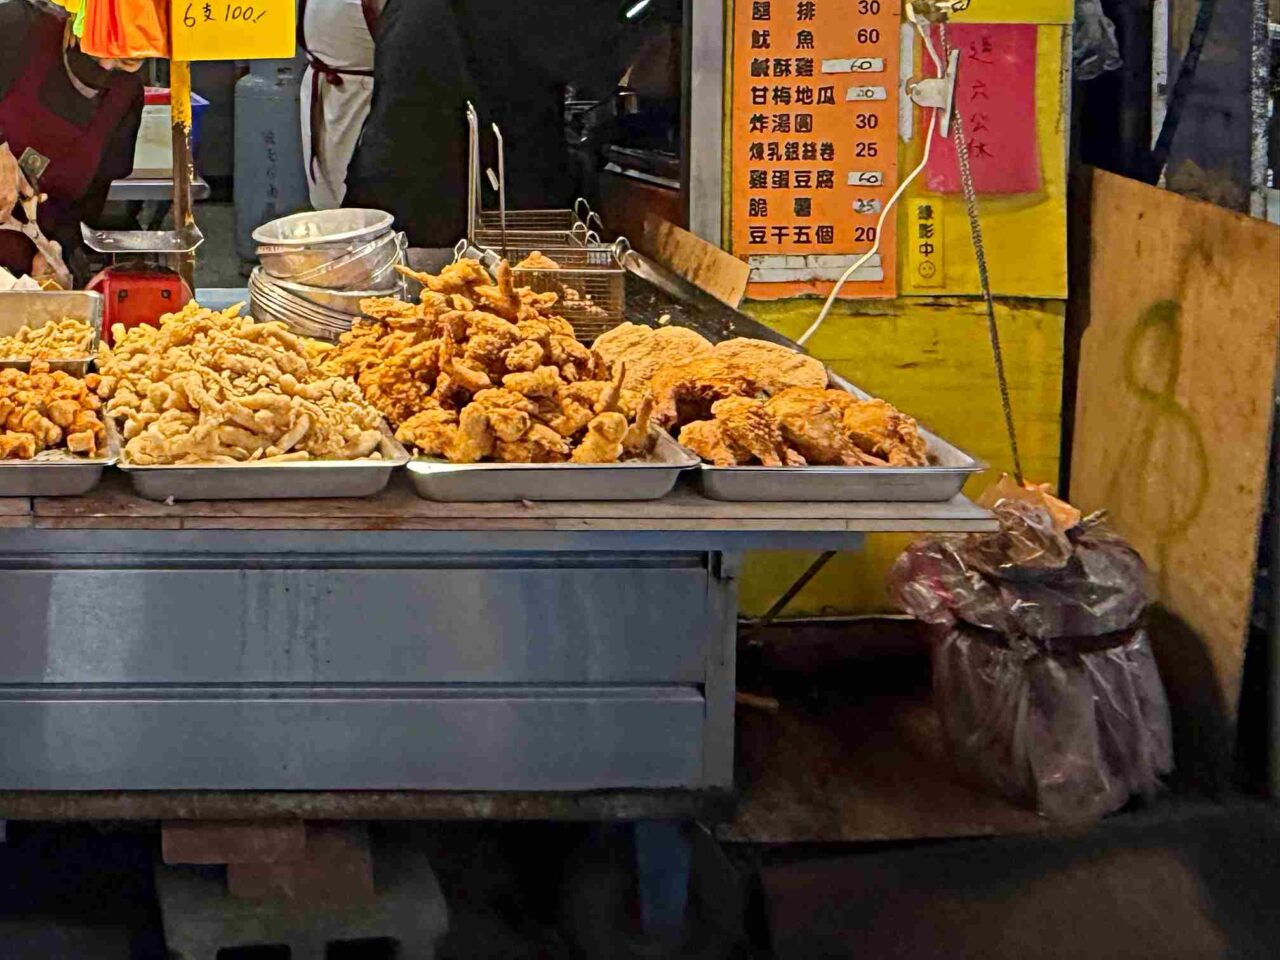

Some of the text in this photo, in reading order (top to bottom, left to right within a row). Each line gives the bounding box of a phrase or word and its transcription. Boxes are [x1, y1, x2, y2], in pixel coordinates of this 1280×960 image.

[752, 0, 881, 21] 腿排 30
[751, 28, 880, 50] 魷魚 60
[750, 57, 814, 77] 鹹酥雞
[750, 86, 836, 105] 甘梅地瓜
[749, 113, 878, 133] 炸湯圓 30
[856, 142, 878, 158] 25
[749, 170, 835, 190] 雞蛋豆腐
[748, 197, 812, 217] 脆薯
[748, 225, 877, 245] 豆干五個 20
